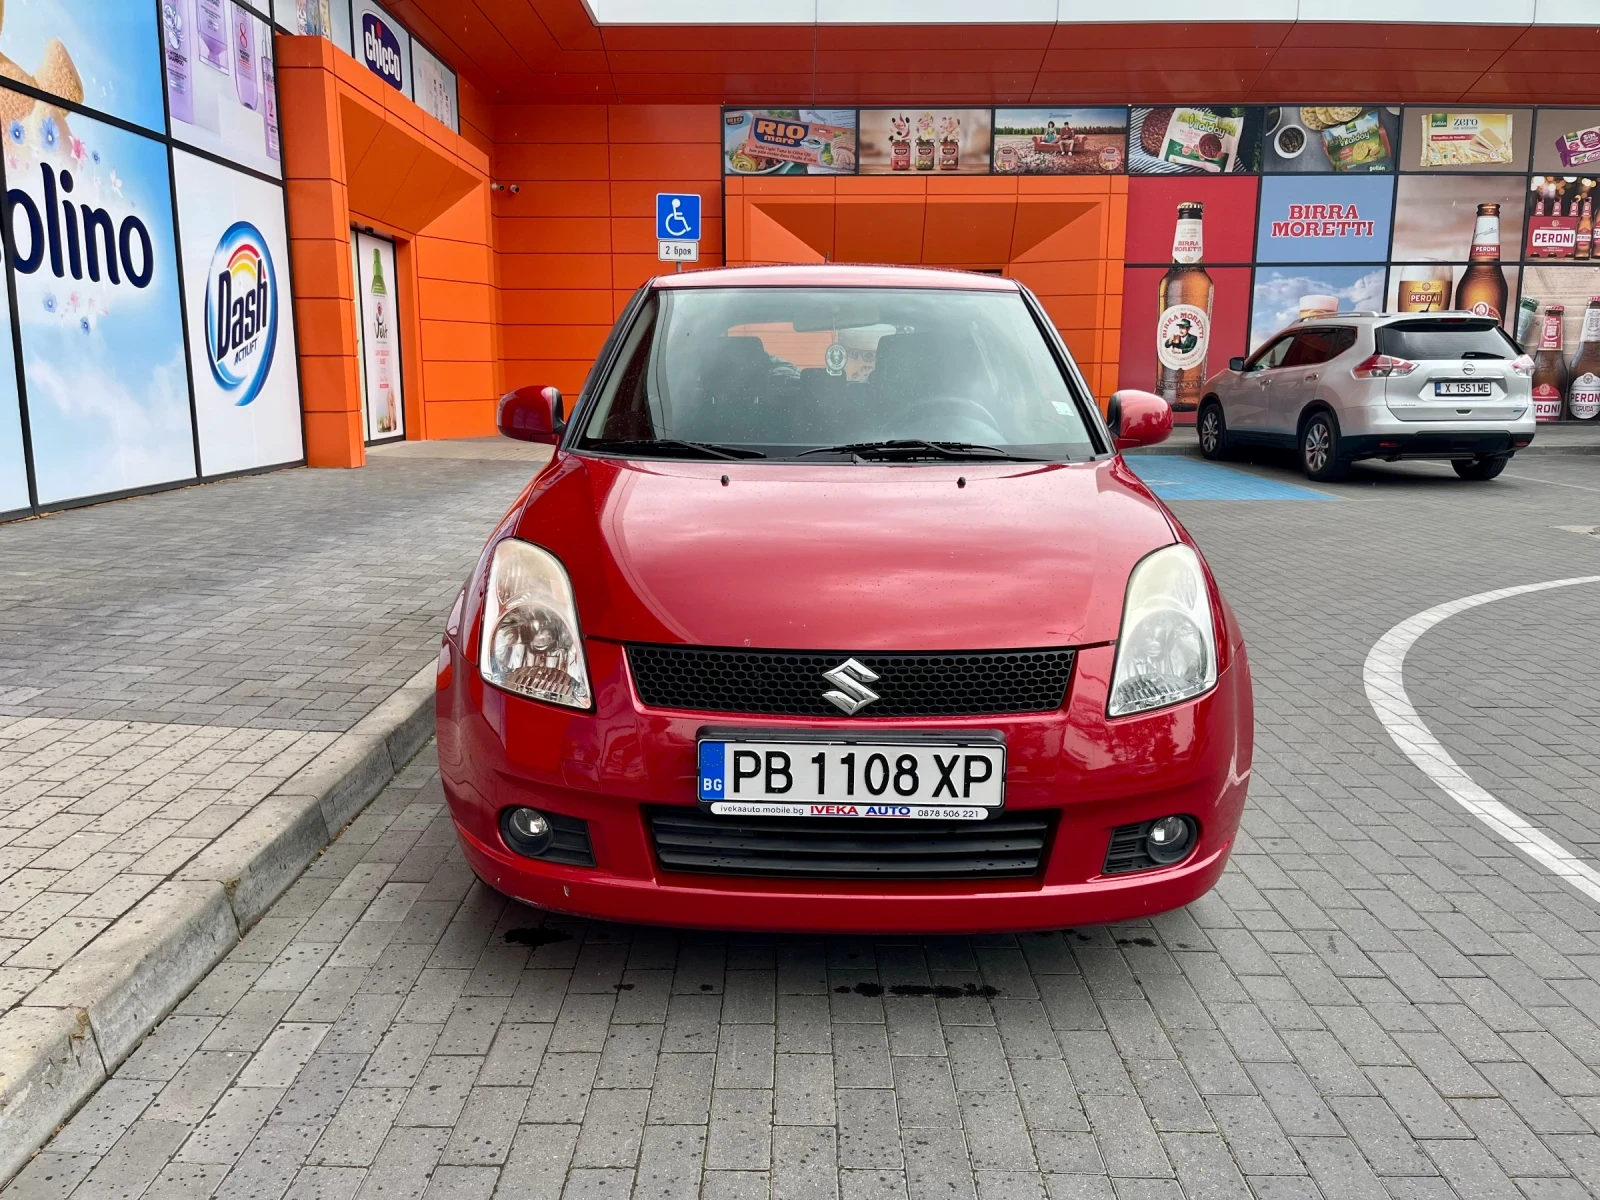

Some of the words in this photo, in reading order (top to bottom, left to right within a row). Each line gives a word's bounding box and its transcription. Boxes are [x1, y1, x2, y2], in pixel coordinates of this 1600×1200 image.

[239, 22, 248, 49] 8
[365, 22, 401, 82] chicco
[757, 120, 805, 139] RIO
[763, 134, 795, 145] mare
[1288, 204, 1360, 220] BIRRA
[1270, 220, 1375, 238] MORETTI
[1534, 233, 1574, 244] PERONI
[665, 245, 671, 255] 2
[673, 245, 692, 257] броя
[1410, 293, 1441, 302] PERONI
[216, 258, 268, 362] Dash
[1162, 314, 1179, 339] BIRRA
[1180, 312, 1204, 339] MORETTI
[233, 337, 258, 366] ACTILIFT
[1445, 383, 1451, 393] X
[1455, 383, 1476, 393] 1551
[1477, 383, 1489, 393] ME
[733, 750, 794, 794] PB
[811, 751, 920, 797] 1108
[931, 754, 993, 798] XP
[703, 778, 723, 791] BG
[720, 804, 804, 815] ivekaauto.mobile.bg
[810, 805, 859, 815] IVEKA
[865, 806, 911, 816] AUTO
[917, 809, 940, 817] 0878
[943, 810, 960, 818] 506
[962, 810, 979, 818] 221
